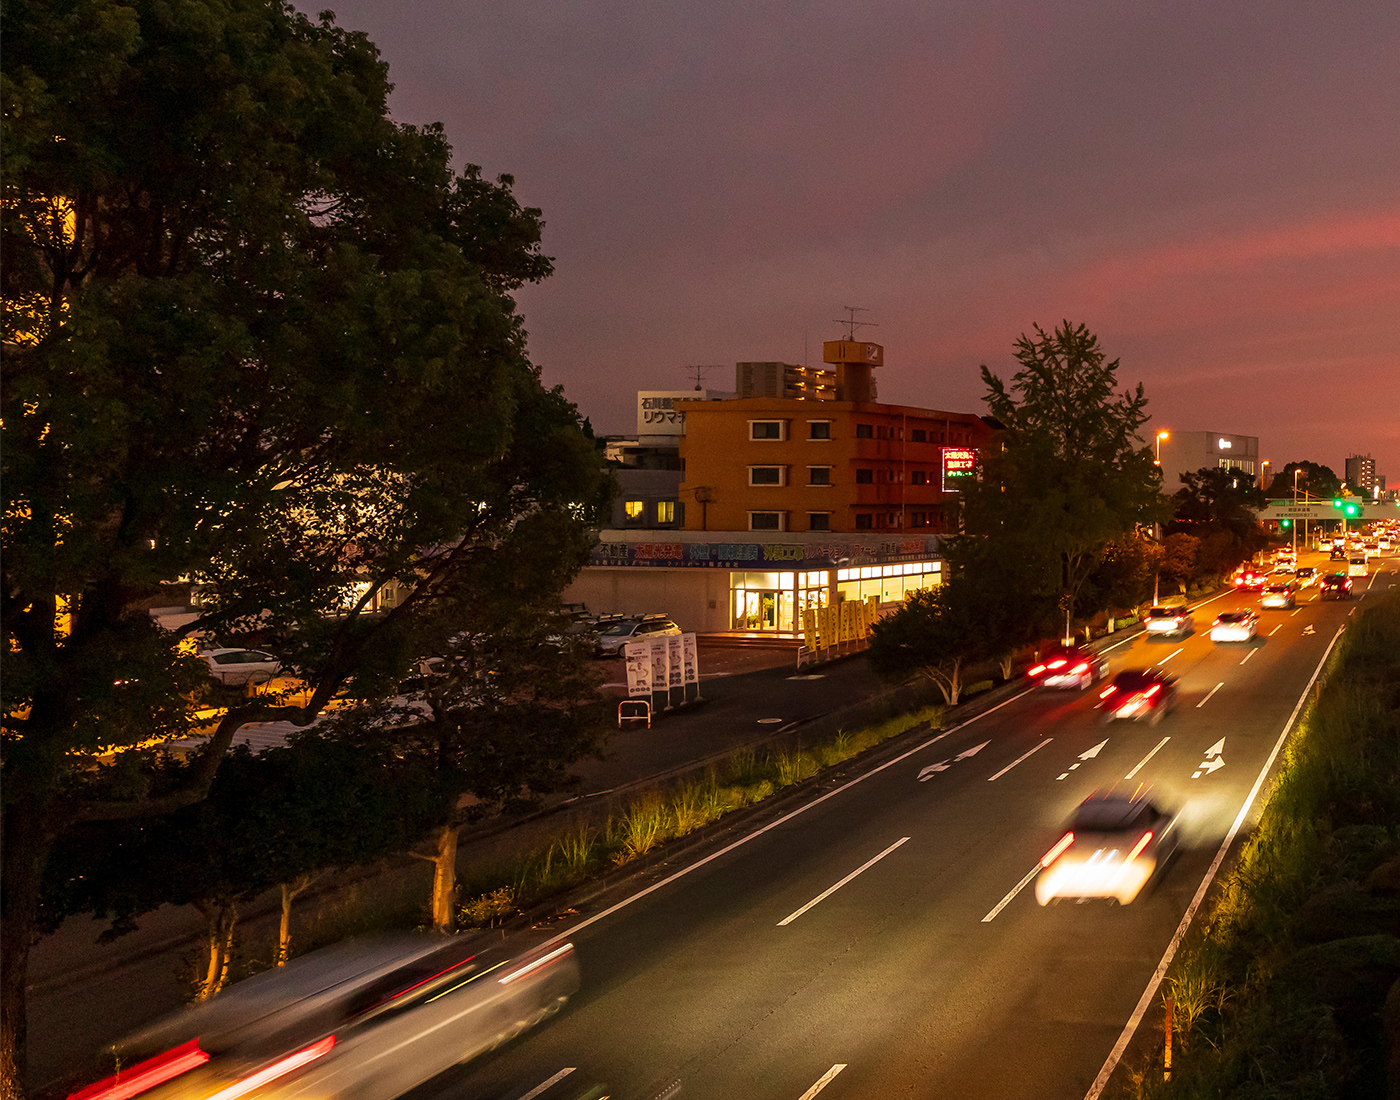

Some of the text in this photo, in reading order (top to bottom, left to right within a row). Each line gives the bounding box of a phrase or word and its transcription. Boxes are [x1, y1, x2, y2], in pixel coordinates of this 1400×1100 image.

[600, 543, 628, 559] 不動産
[634, 543, 684, 560] 太陽光発電
[763, 544, 804, 561] 外装工事
